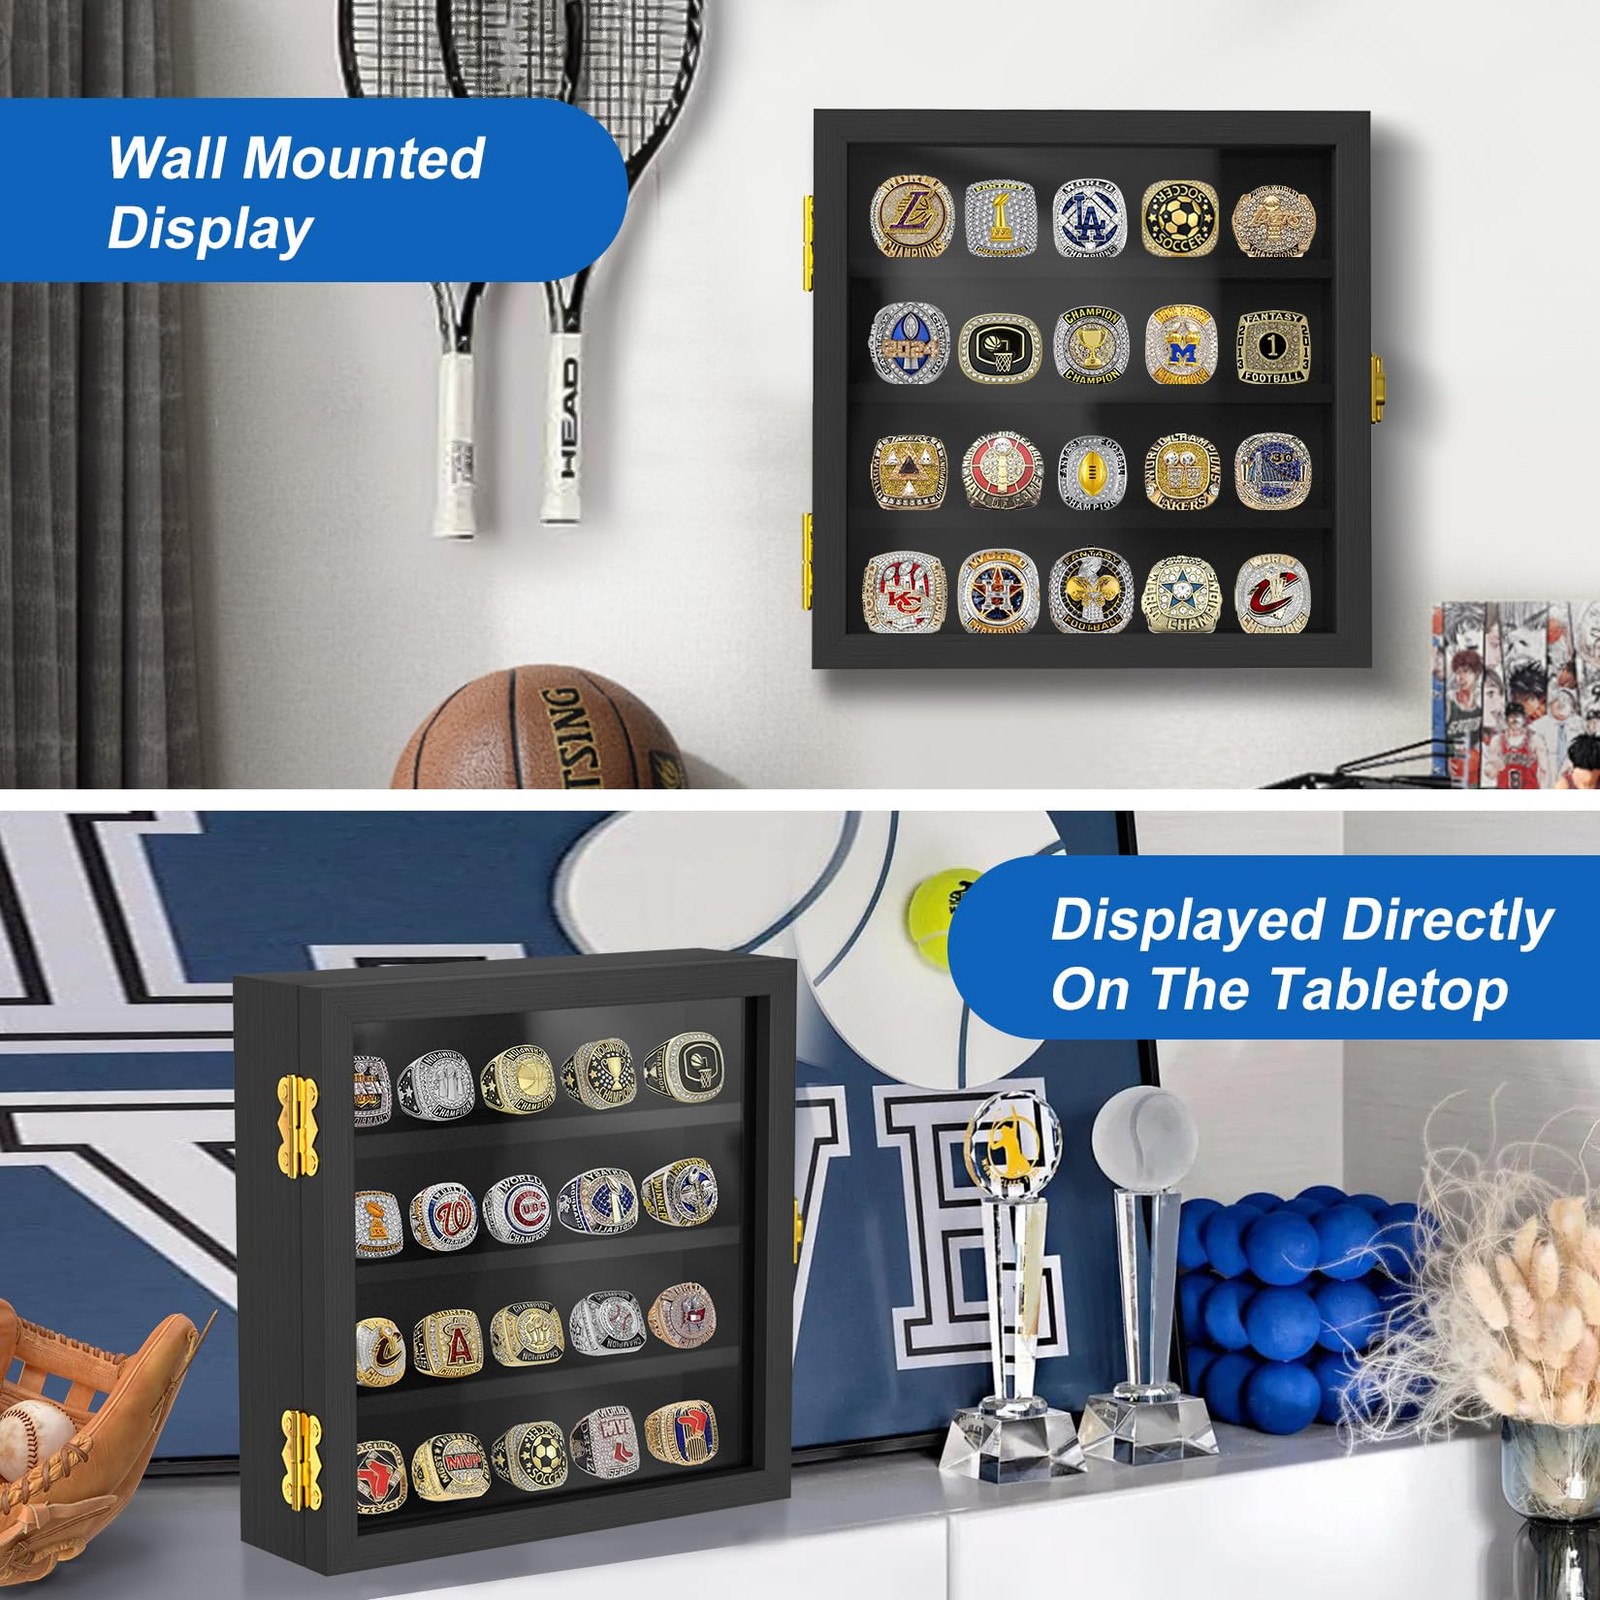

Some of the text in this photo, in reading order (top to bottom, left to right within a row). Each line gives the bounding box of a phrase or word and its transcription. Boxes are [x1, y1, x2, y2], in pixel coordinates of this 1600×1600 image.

[1064, 179, 1115, 194] WORLD
[1157, 185, 1204, 204] SOCCER
[1073, 194, 1107, 241] LA
[1155, 233, 1206, 251] SOCCER
[1064, 245, 1118, 258] CHAMPIONS
[1064, 307, 1120, 324] CHAMPION
[1245, 313, 1302, 323] FANTASY
[931, 313, 946, 375] CHAMPION
[1237, 325, 1247, 370] 2013
[1267, 333, 1279, 357] 1
[1301, 325, 1311, 370] 2013
[1169, 342, 1198, 364] M
[1064, 368, 1120, 385] CHAMPION
[1245, 371, 1302, 384] FOOTBALL
[561, 357, 579, 478] HEAD
[1066, 494, 1117, 511] CHAMPION
[1157, 496, 1208, 511] LAKERS
[970, 552, 1027, 569] WORLD
[1064, 548, 1121, 565] FANTASY
[1251, 554, 1297, 567] WORLD
[887, 591, 922, 614] KC
[969, 619, 1028, 634] CHAMPIONS
[1064, 617, 1122, 632] FOOTBALL
[658, 1050, 666, 1092] CHAMPION
[599, 1083, 634, 1103] CHAMPION
[434, 1101, 473, 1117] CHAMPION
[517, 1096, 553, 1111] CHAMPION
[501, 1174, 542, 1193] WORLD
[653, 1177, 670, 1221] WINNER
[433, 1309, 474, 1319] WORLD
[512, 1303, 550, 1313] CHAMPION
[447, 1327, 476, 1366] A
[435, 1433, 478, 1448] VALUABLE
[434, 1455, 451, 1484] MOST
[445, 1453, 481, 1471] MVP
[529, 1466, 566, 1485] SOCCER
